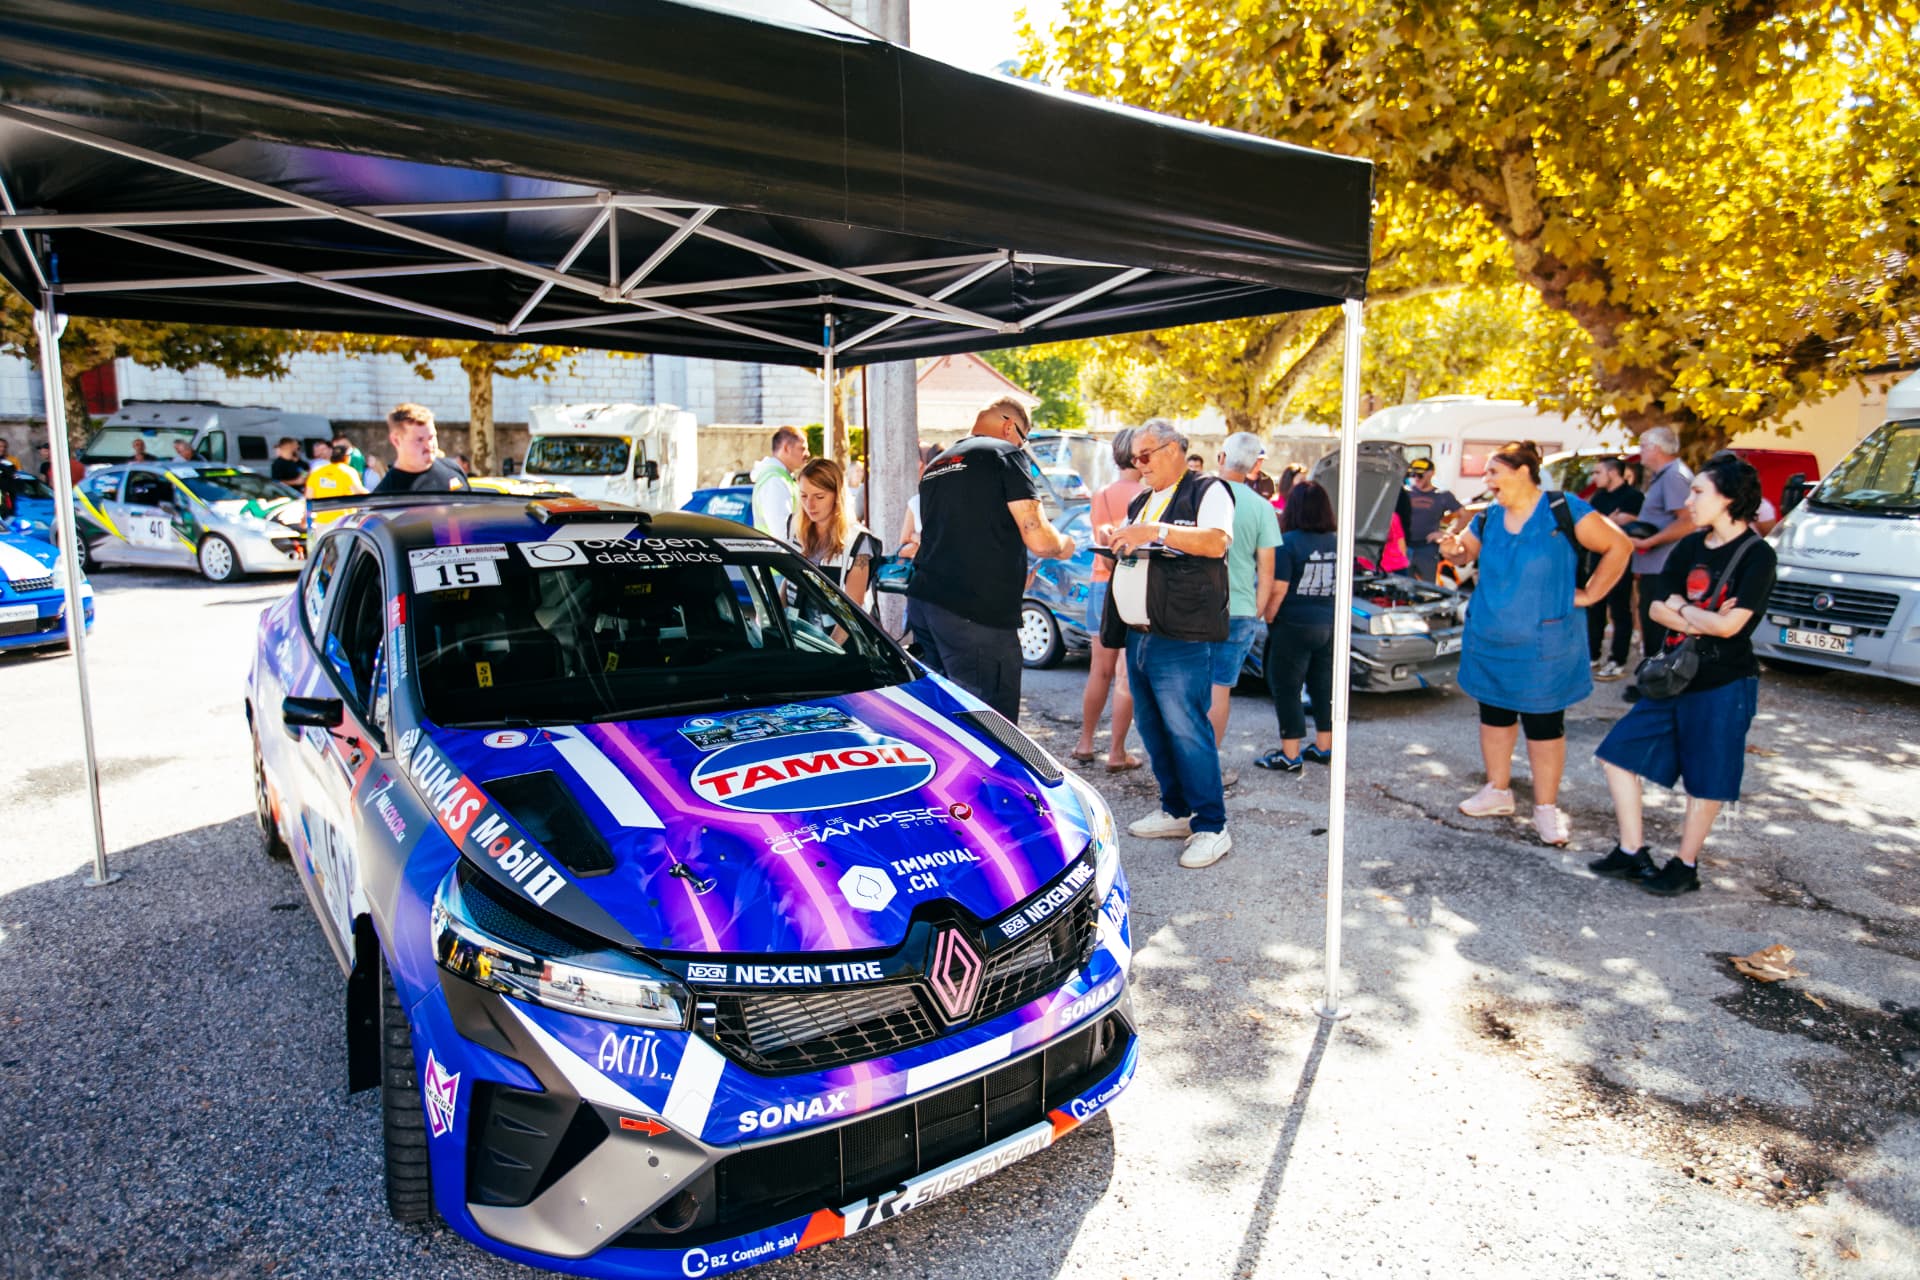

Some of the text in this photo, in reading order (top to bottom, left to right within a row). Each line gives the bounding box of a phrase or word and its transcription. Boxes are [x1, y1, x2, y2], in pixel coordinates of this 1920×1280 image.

[149, 520, 165, 539] 40
[595, 550, 723, 565] data pilots
[437, 562, 480, 587] 15
[1786, 630, 1846, 651] BL 416 ZN
[496, 734, 516, 744] E
[698, 747, 928, 797] TAMOIL
[411, 745, 480, 830] DUMAS
[765, 816, 845, 845] GARAGE DE
[770, 807, 950, 855] CHAMPSEC
[900, 818, 949, 829] SION
[470, 813, 544, 884] Mobil
[890, 848, 981, 876] IMMOVAL
[906, 872, 940, 894] .CH
[1024, 882, 1073, 923] NEXEN
[1063, 861, 1095, 890] TIRE
[735, 965, 823, 984] NEXEN
[825, 961, 884, 983] TIRE
[1061, 981, 1117, 1026] SONAX
[738, 1091, 847, 1133] SONAX
[914, 1133, 1048, 1207] SUSPENSION
[710, 1254, 728, 1268] BZ
[731, 1241, 775, 1262] Consult
